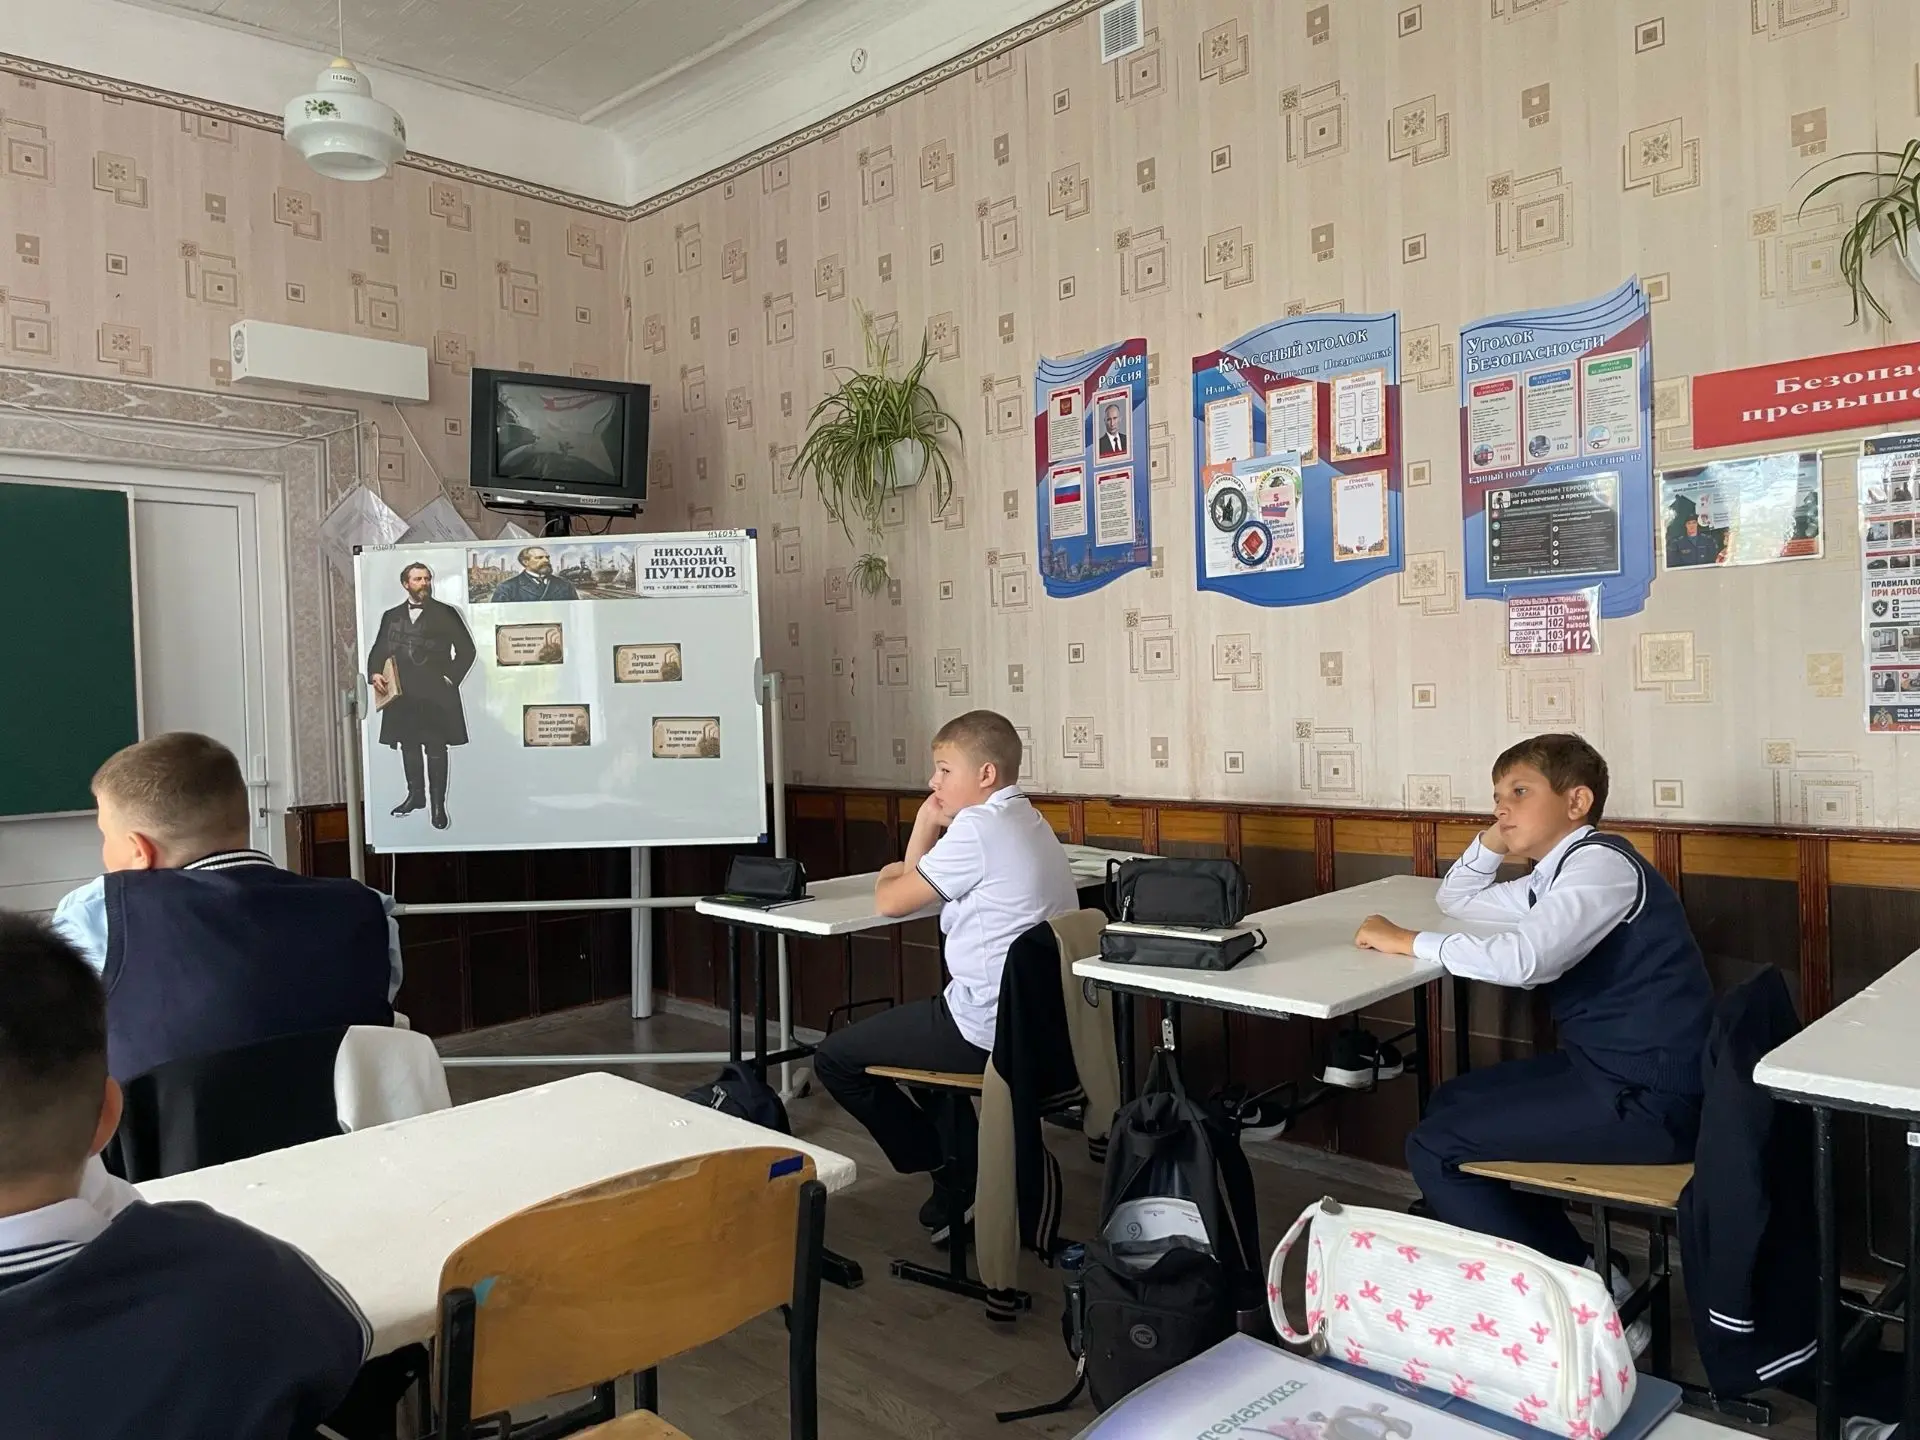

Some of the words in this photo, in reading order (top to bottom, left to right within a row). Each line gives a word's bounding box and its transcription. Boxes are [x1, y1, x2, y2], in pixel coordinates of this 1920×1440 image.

[1776, 364, 1920, 395] Безопа
[1556, 442, 1569, 450] 102
[1273, 493, 1280, 502] 5
[654, 545, 723, 557] НИКОЛАЙ
[650, 557, 728, 567] ИВАНОВИЧ
[645, 566, 737, 579] ПУТИЛОВ
[1871, 579, 1909, 588] ПРАВИЛА
[1871, 588, 1889, 597] ПРИ
[1548, 605, 1564, 615] 101
[1548, 618, 1564, 628] 102
[1548, 629, 1564, 639] 103
[1564, 630, 1591, 650] 112
[1548, 642, 1564, 653] 104
